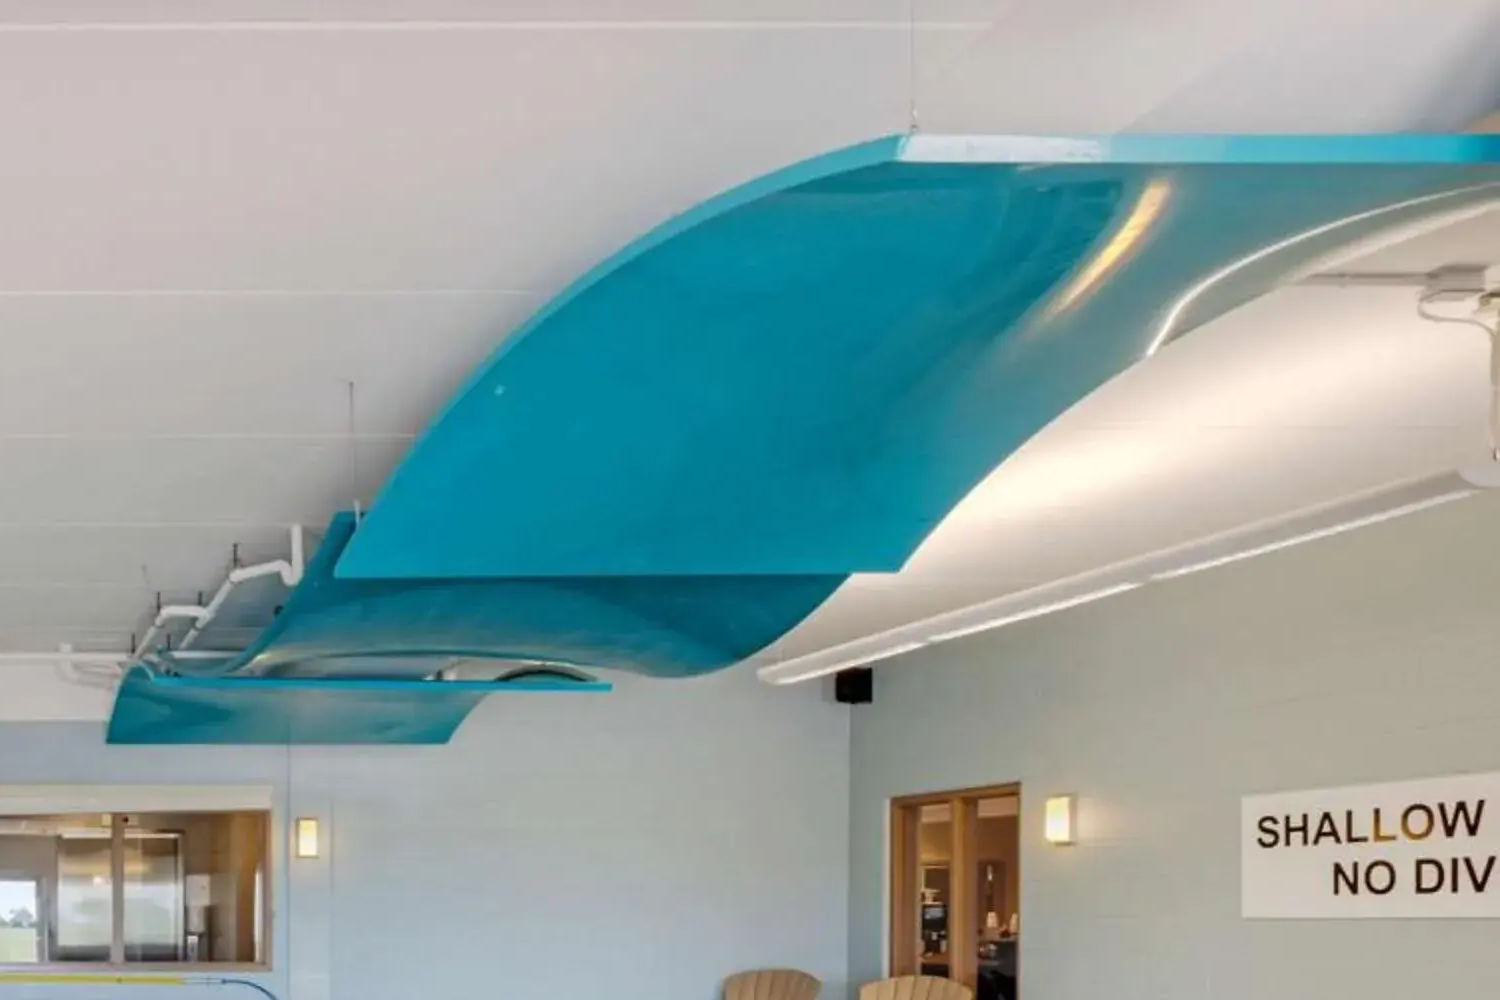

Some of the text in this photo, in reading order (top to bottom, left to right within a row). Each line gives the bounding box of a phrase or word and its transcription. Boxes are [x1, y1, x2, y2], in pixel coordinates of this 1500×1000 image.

[1257, 799, 1485, 848] SHALLOW
[1333, 856, 1496, 895] NO DIV
